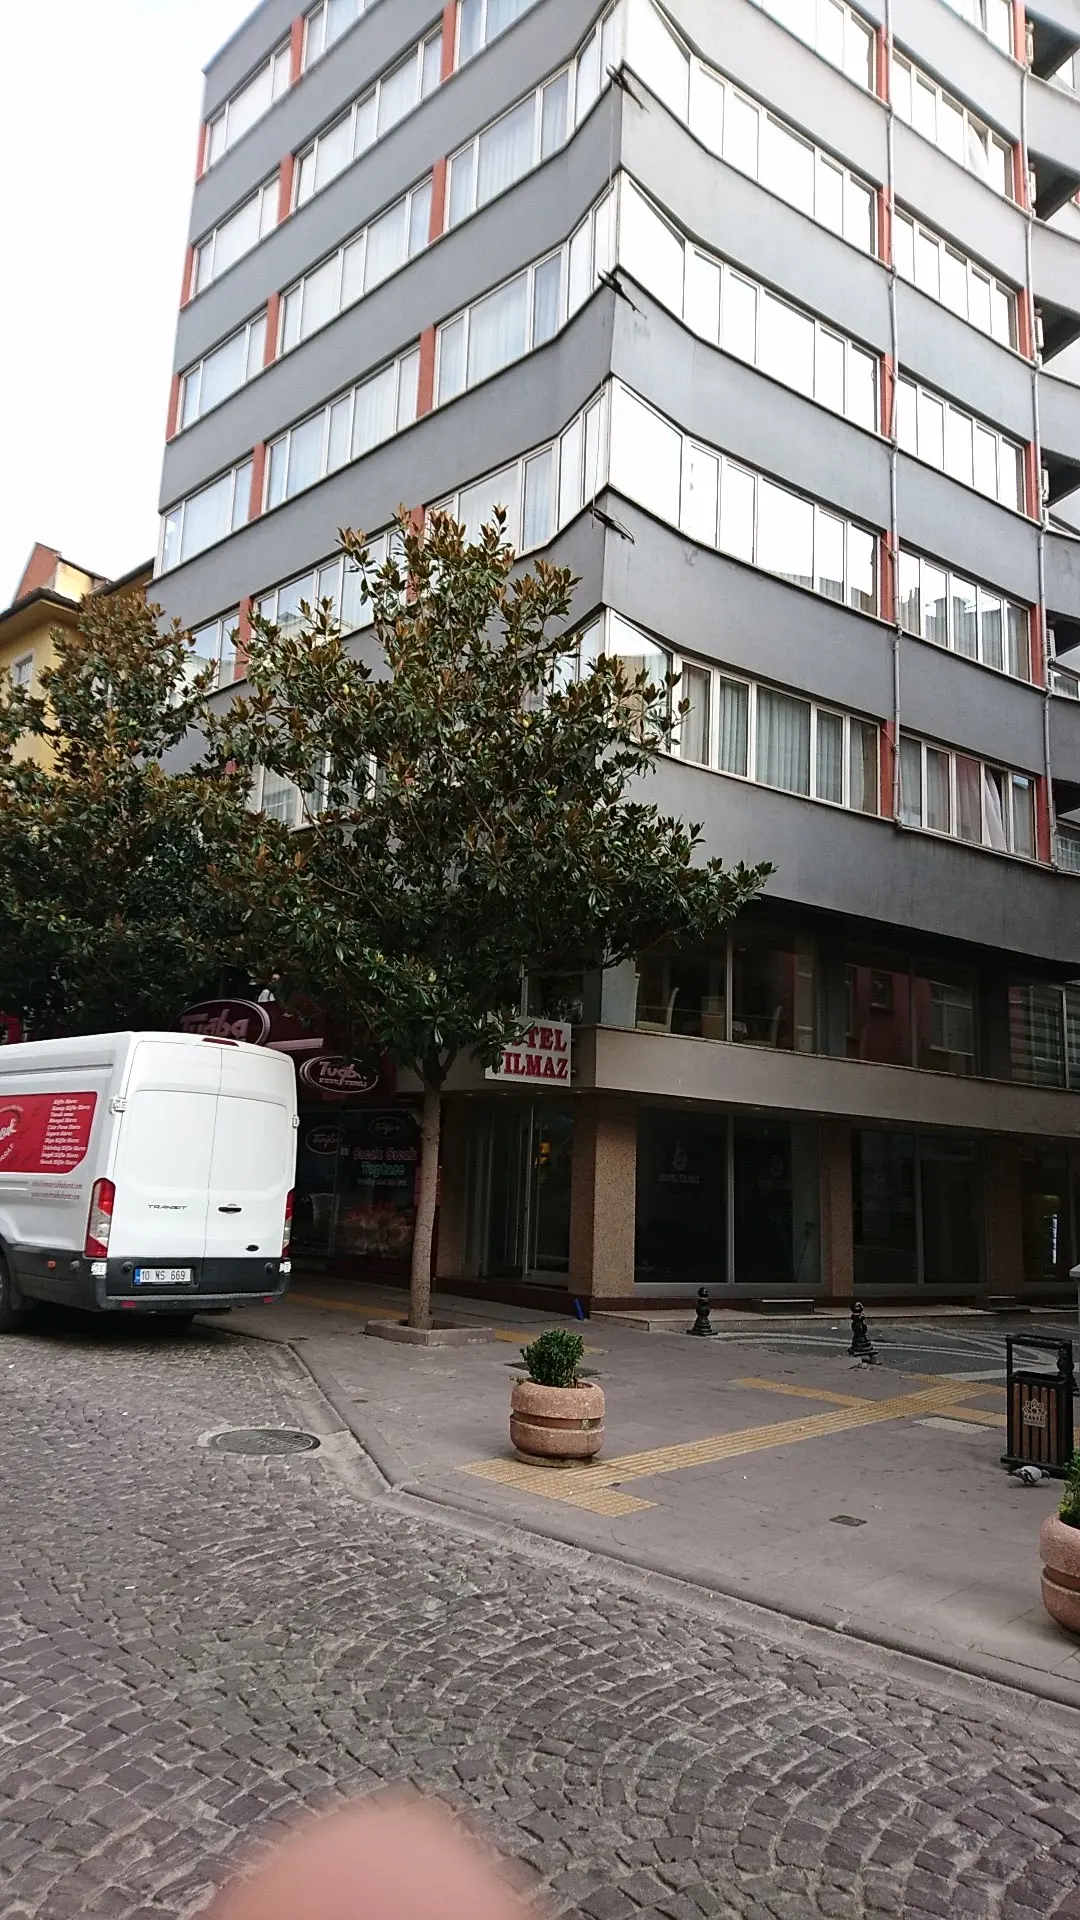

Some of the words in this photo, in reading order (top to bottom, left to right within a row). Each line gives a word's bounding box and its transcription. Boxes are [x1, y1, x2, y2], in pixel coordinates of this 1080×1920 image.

[511, 1025, 568, 1052] TEL
[501, 1051, 569, 1080] ILMAZ
[141, 1270, 150, 1281] 10
[170, 1270, 186, 1281] 669
